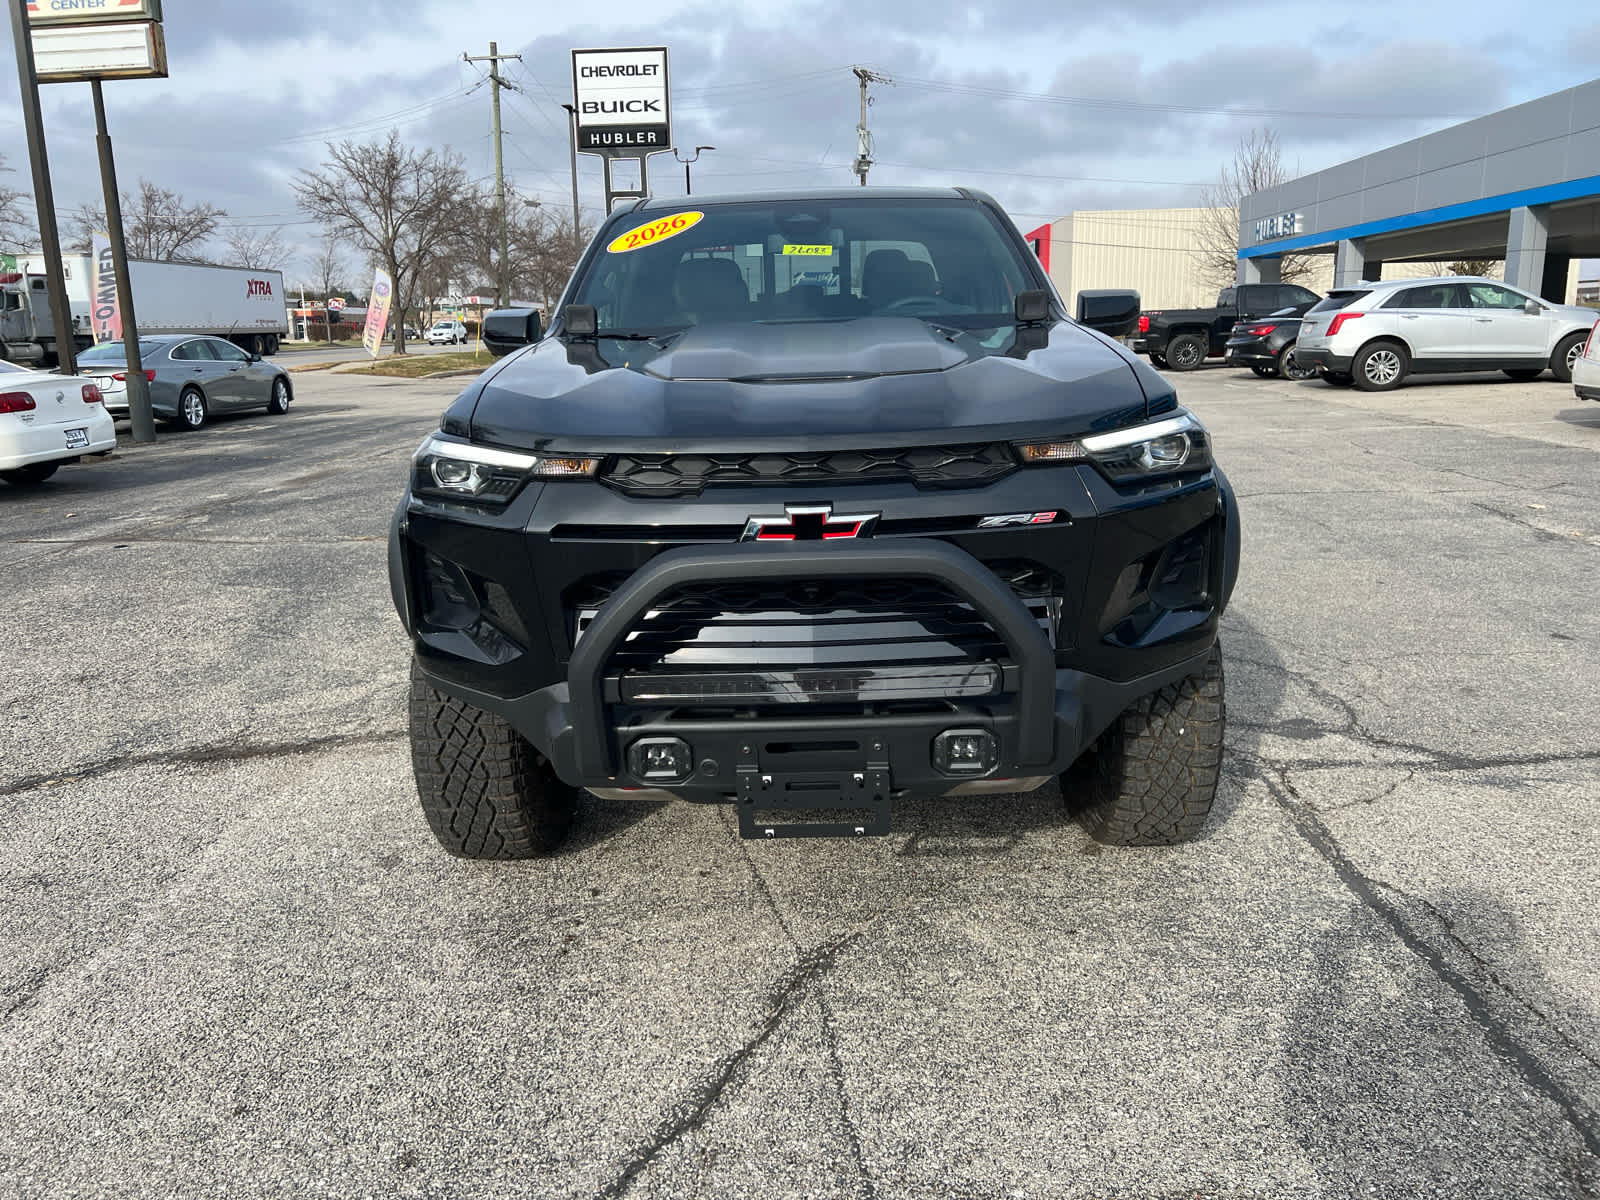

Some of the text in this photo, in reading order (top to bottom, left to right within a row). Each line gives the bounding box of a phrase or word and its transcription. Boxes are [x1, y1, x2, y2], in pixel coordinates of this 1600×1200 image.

[51, 0, 106, 10] CENTER
[581, 64, 659, 77] CHEVROLET
[582, 99, 662, 114] BUICK
[590, 132, 657, 144] HUBLER
[625, 215, 686, 248] 2026
[1255, 211, 1304, 241] HUBLER
[246, 279, 272, 298] XTRA
[976, 511, 1057, 528] ZR2
